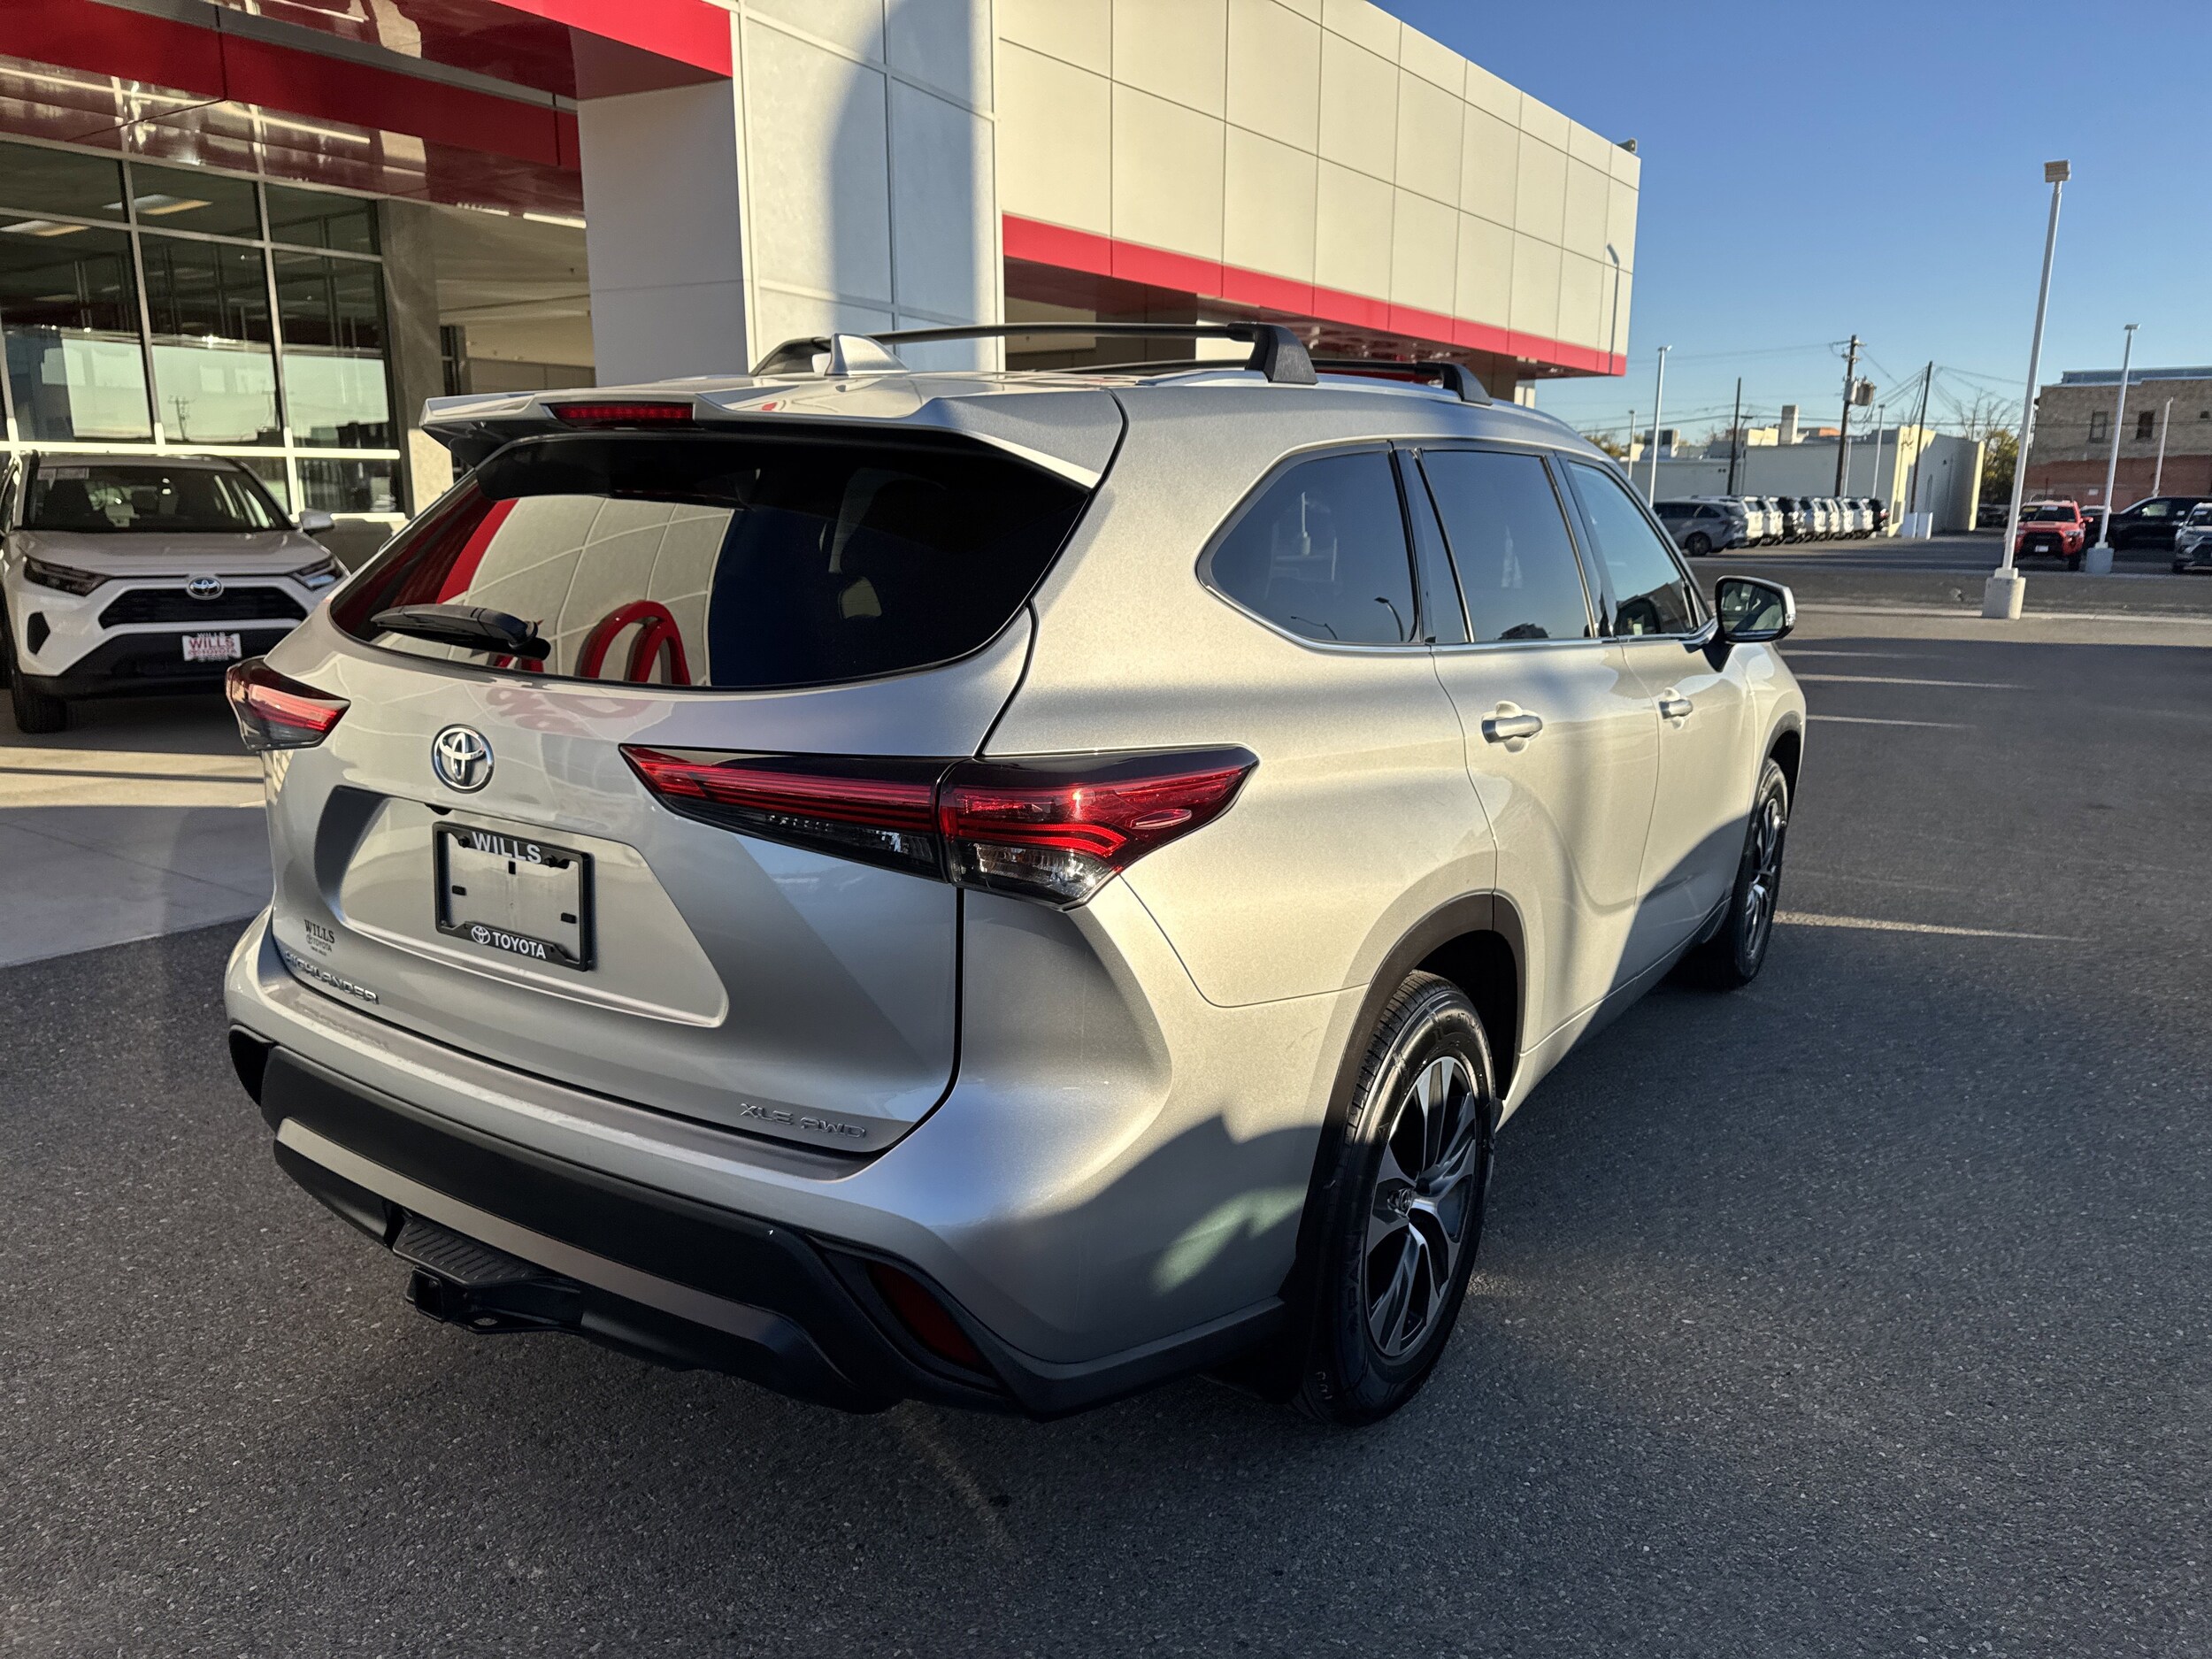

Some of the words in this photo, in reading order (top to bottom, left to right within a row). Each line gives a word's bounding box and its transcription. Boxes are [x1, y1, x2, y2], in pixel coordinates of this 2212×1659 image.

[189, 637, 235, 649] WILLS
[472, 832, 541, 864] WILLS
[303, 918, 335, 944] WILLS
[311, 936, 333, 952] TOYOTA
[492, 932, 547, 959] TOYOTA
[285, 950, 380, 1004] HIGHLANDER
[740, 1102, 794, 1125] XLE
[800, 1117, 866, 1138] AWD
